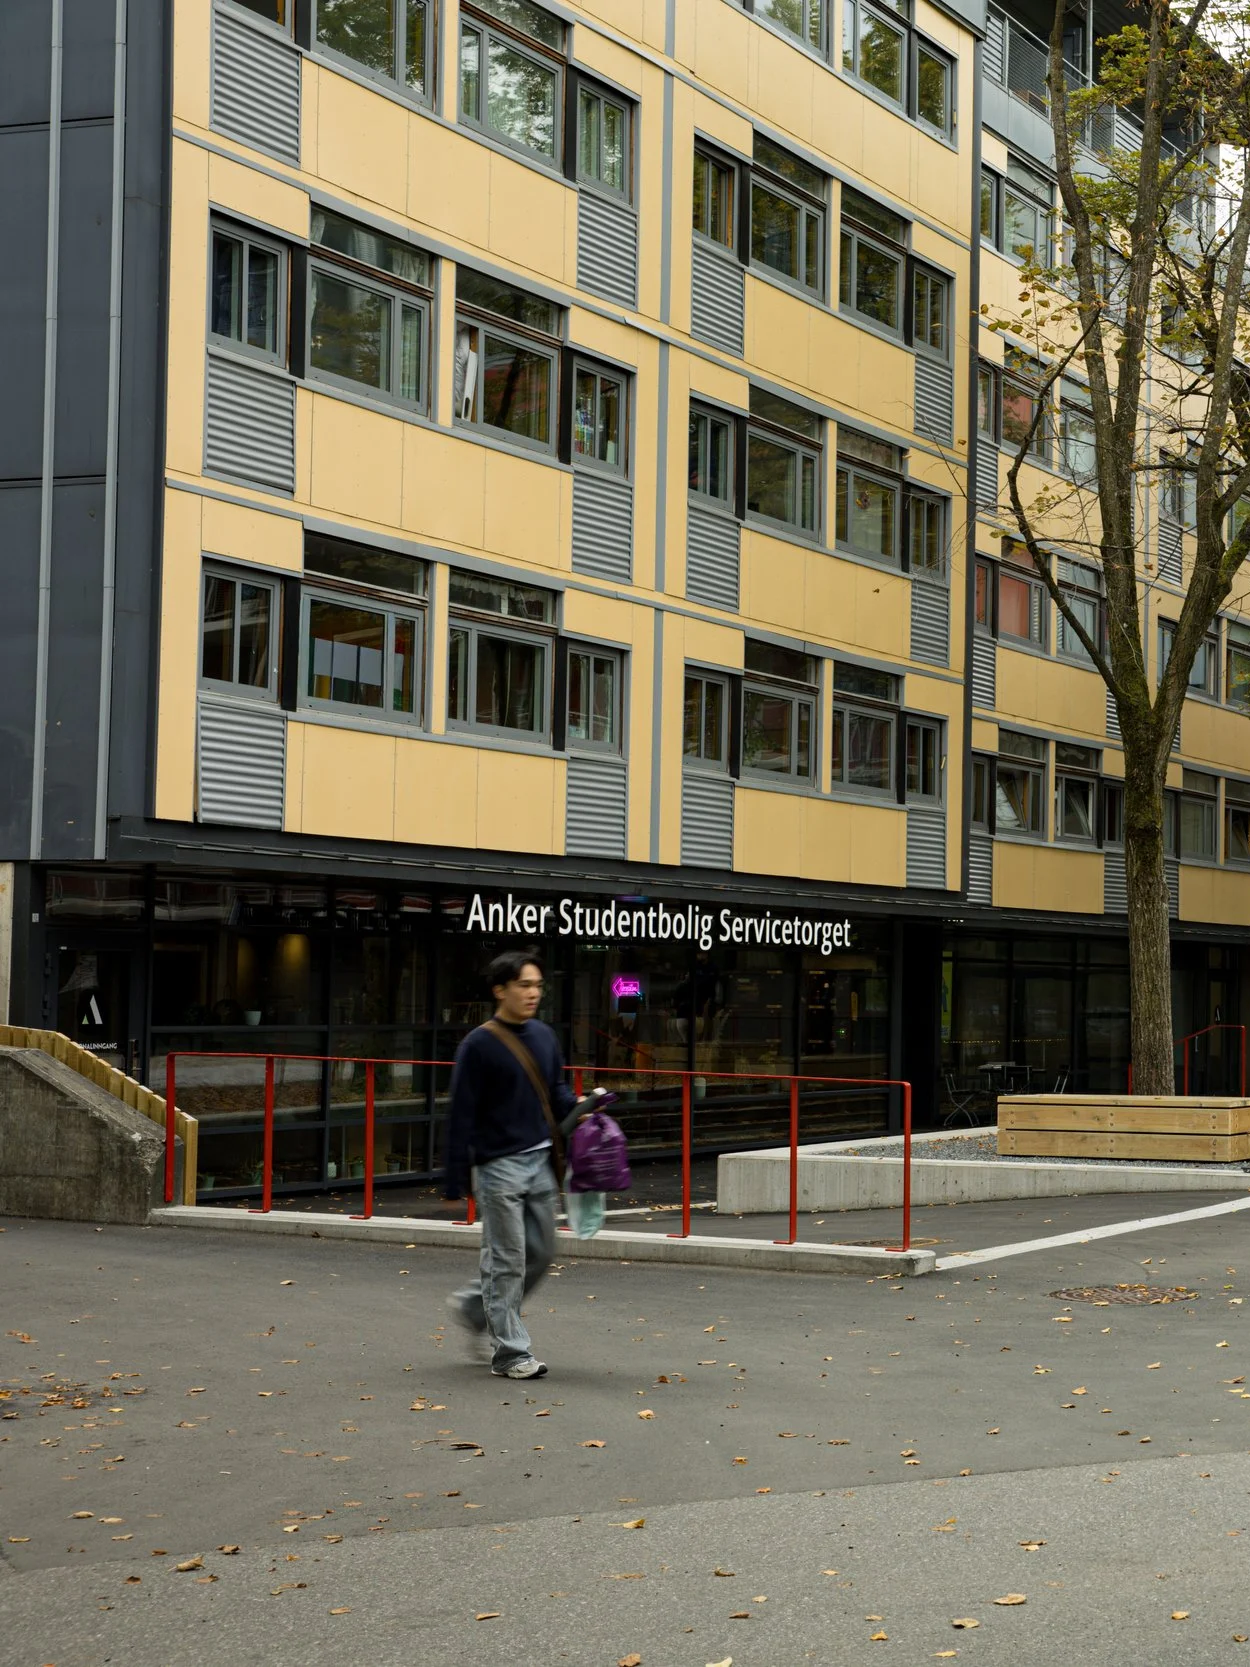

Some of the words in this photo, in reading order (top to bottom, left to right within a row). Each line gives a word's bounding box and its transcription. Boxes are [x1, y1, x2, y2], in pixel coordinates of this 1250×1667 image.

[466, 893, 551, 935] Anker
[558, 898, 713, 951] Studentbolig
[719, 907, 851, 956] Servicetorget
